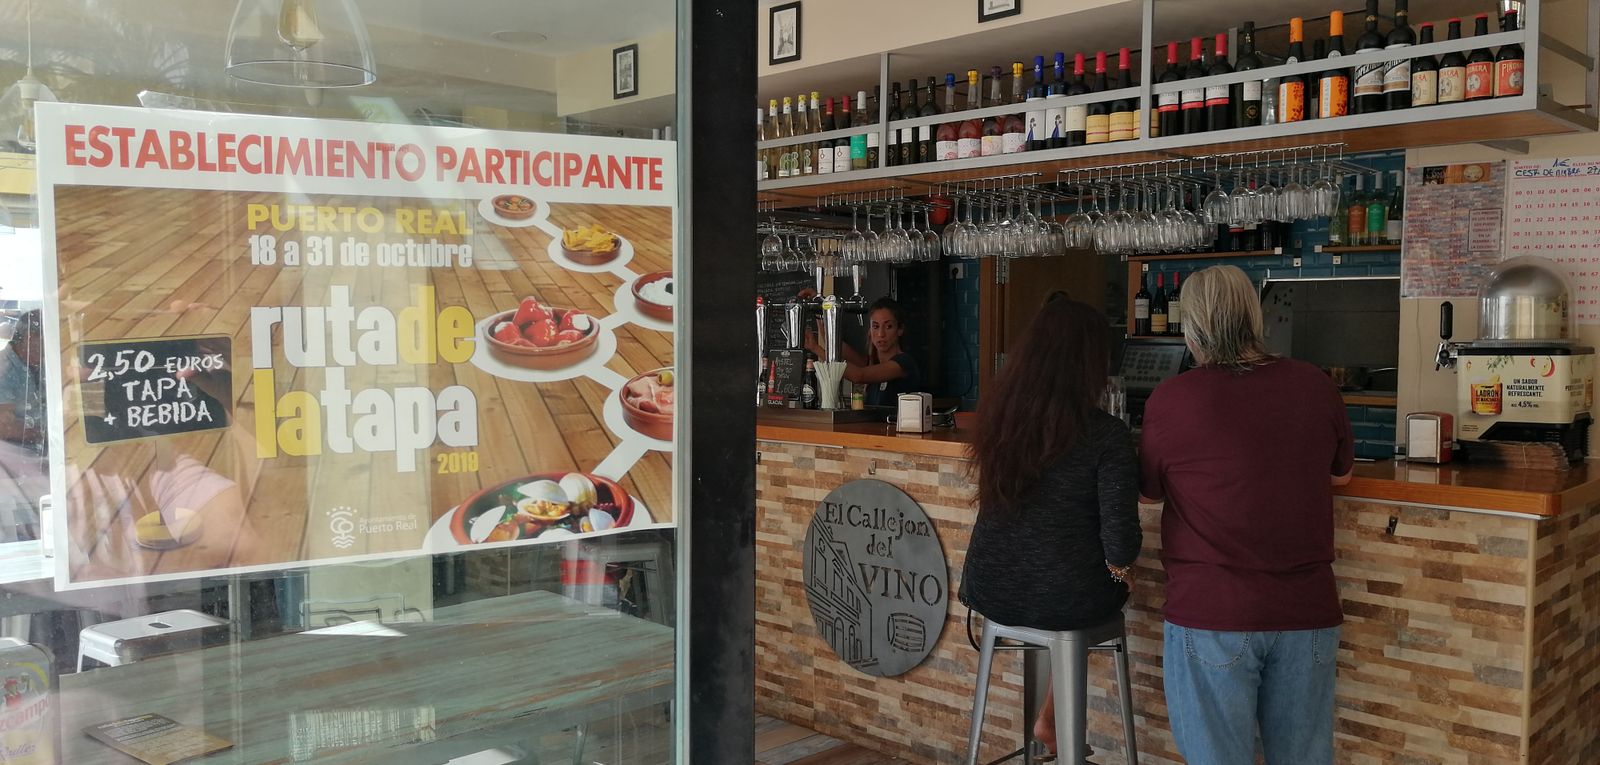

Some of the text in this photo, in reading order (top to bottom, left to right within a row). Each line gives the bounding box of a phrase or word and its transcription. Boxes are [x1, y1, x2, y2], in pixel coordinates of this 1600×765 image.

[65, 124, 663, 191] ESTABLECIMIENTO PARTICIPANTE
[247, 203, 473, 235] PUERTO REAL
[248, 234, 473, 268] 18 a 31 de octubre
[87, 350, 224, 381] 2,50 EUROS
[121, 376, 192, 402] TAPA
[103, 400, 213, 428] + BEBIDA
[1518, 400, 1533, 409] 4,5%
[437, 452, 480, 474] 2019
[360, 519, 417, 534] Puerto Real
[824, 501, 931, 541] El Callejon
[866, 533, 894, 559] del
[858, 562, 943, 607] VINO
